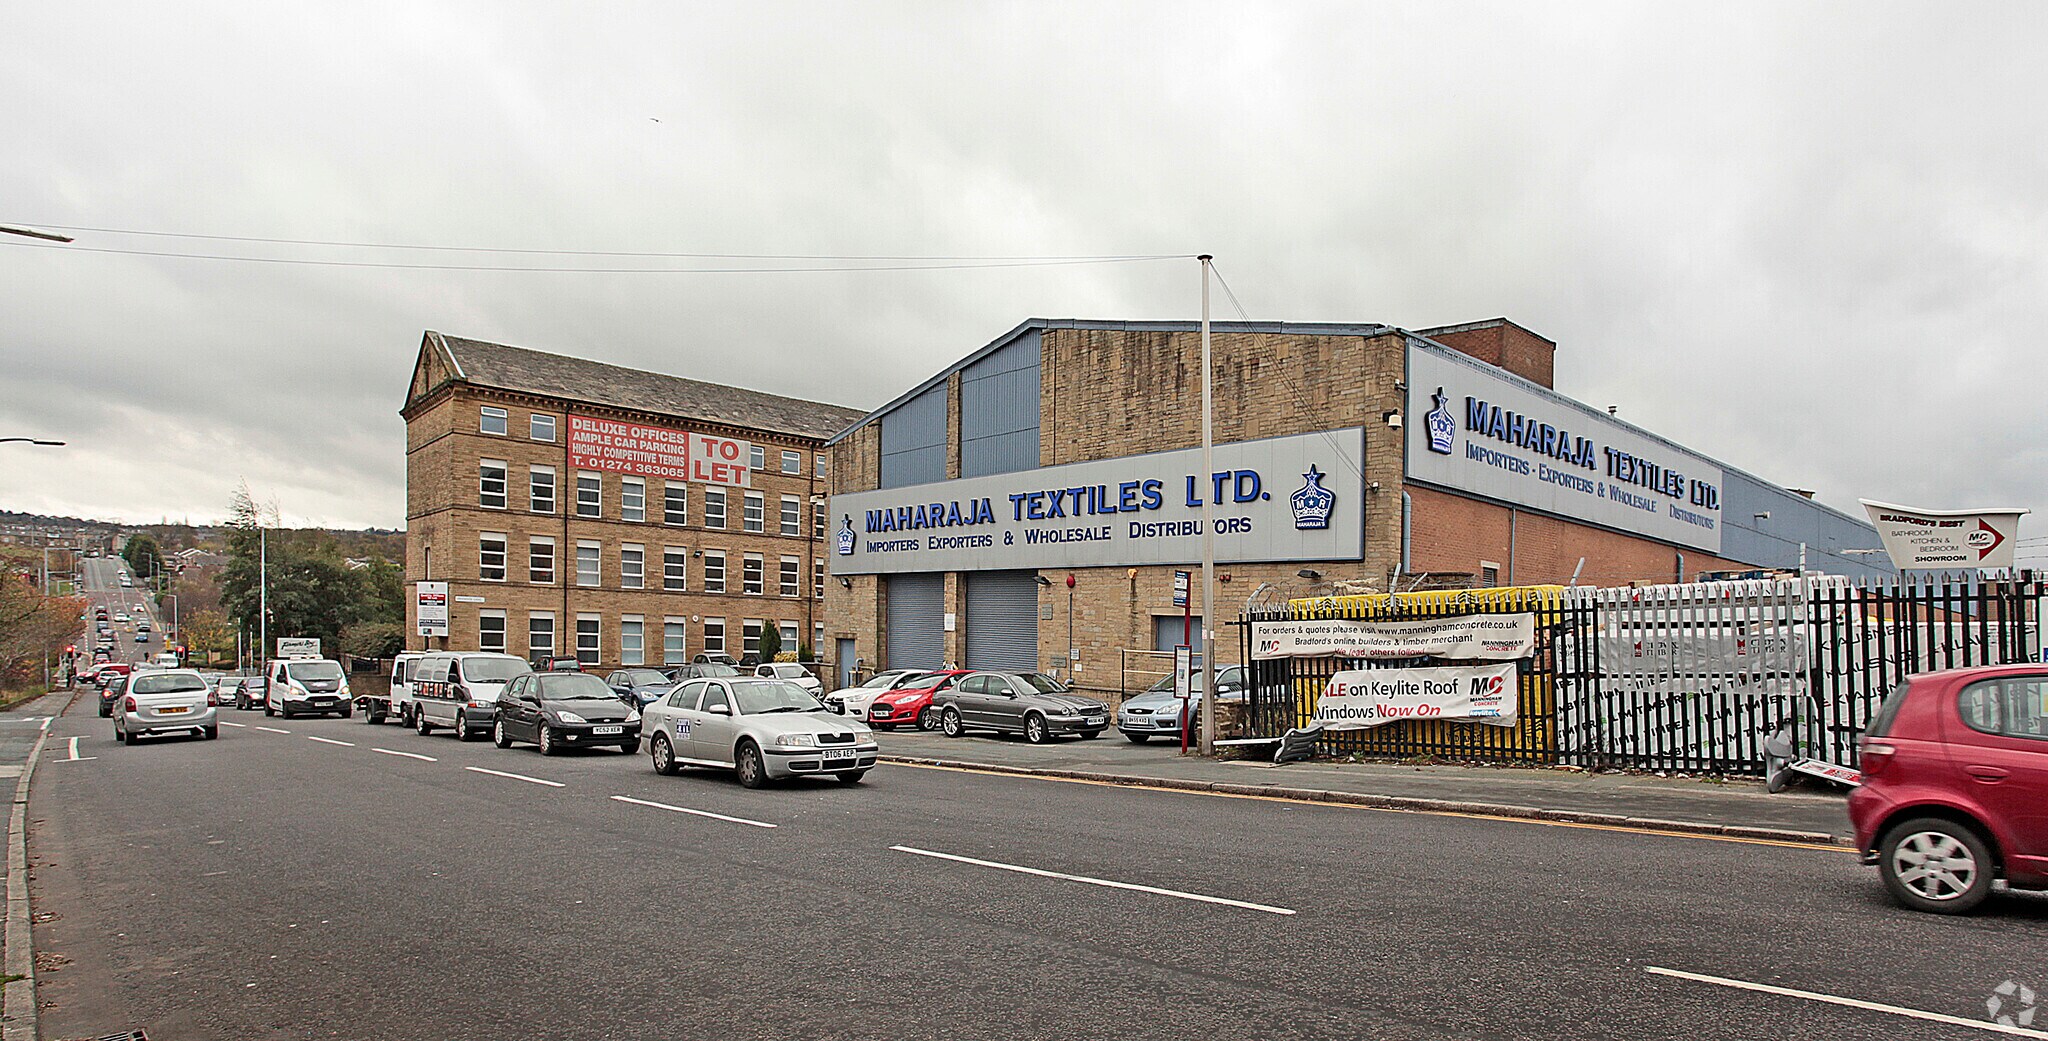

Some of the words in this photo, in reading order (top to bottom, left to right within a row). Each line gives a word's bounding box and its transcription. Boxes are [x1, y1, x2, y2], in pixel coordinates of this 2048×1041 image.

[572, 418, 627, 436] DELUXE
[631, 427, 685, 444] OFFICES
[572, 431, 612, 445] AMPLE
[614, 437, 637, 449] CAR
[640, 440, 685, 455] PARKING
[701, 437, 740, 461] TO
[1465, 396, 1597, 470] MAHARAJA
[1604, 446, 1686, 500] TEXTILES
[1690, 479, 1720, 510] LTD.
[572, 443, 602, 457] HIGHLY
[603, 447, 657, 464] COMPETITIVE
[659, 455, 685, 467] TERMS
[572, 456, 585, 466] T.
[589, 458, 632, 471] 01274
[636, 464, 685, 477] 363065
[694, 460, 747, 485] LET
[1465, 439, 1530, 476] IMPORTERS
[1538, 463, 1594, 494] EXPORTERS
[1597, 481, 1605, 498] &
[1609, 484, 1658, 513] WHOLESALE
[1669, 503, 1715, 530] DISTRIBUTORS
[865, 497, 996, 533] MAHARAJA
[1008, 478, 1164, 522] TEXTILES
[1184, 468, 1272, 508] LTD.
[1880, 514, 1937, 527] BRADFORD'S
[1939, 520, 1966, 528] BEST
[866, 539, 920, 554] IMPORTERS
[928, 534, 994, 550] EXPORTERS
[1003, 530, 1015, 546] &
[1025, 526, 1112, 544] WHOLESALE
[1128, 516, 1252, 539] DISTRIBUORS
[1891, 529, 1933, 537] BATHROOM
[1914, 555, 1968, 563] SHOWROOM
[1258, 626, 1271, 635] For
[1272, 626, 1296, 635] orders
[1298, 626, 1304, 634] &
[1305, 625, 1331, 636] quotes
[1332, 624, 1359, 636] please
[1377, 620, 1519, 636] www.manninghamconcrete.co.uk
[1295, 637, 1332, 646] Bradford's
[1333, 637, 1357, 646] online
[1358, 637, 1392, 646] builders
[1394, 638, 1400, 646] &
[1402, 638, 1429, 646] timber
[1431, 634, 1474, 645] merchant
[1349, 685, 1369, 697] on
[1371, 681, 1420, 700] Keylite
[1423, 679, 1459, 695] Roof
[1469, 676, 1507, 698] MC
[1376, 704, 1414, 718] Now
[1416, 703, 1442, 717] On
